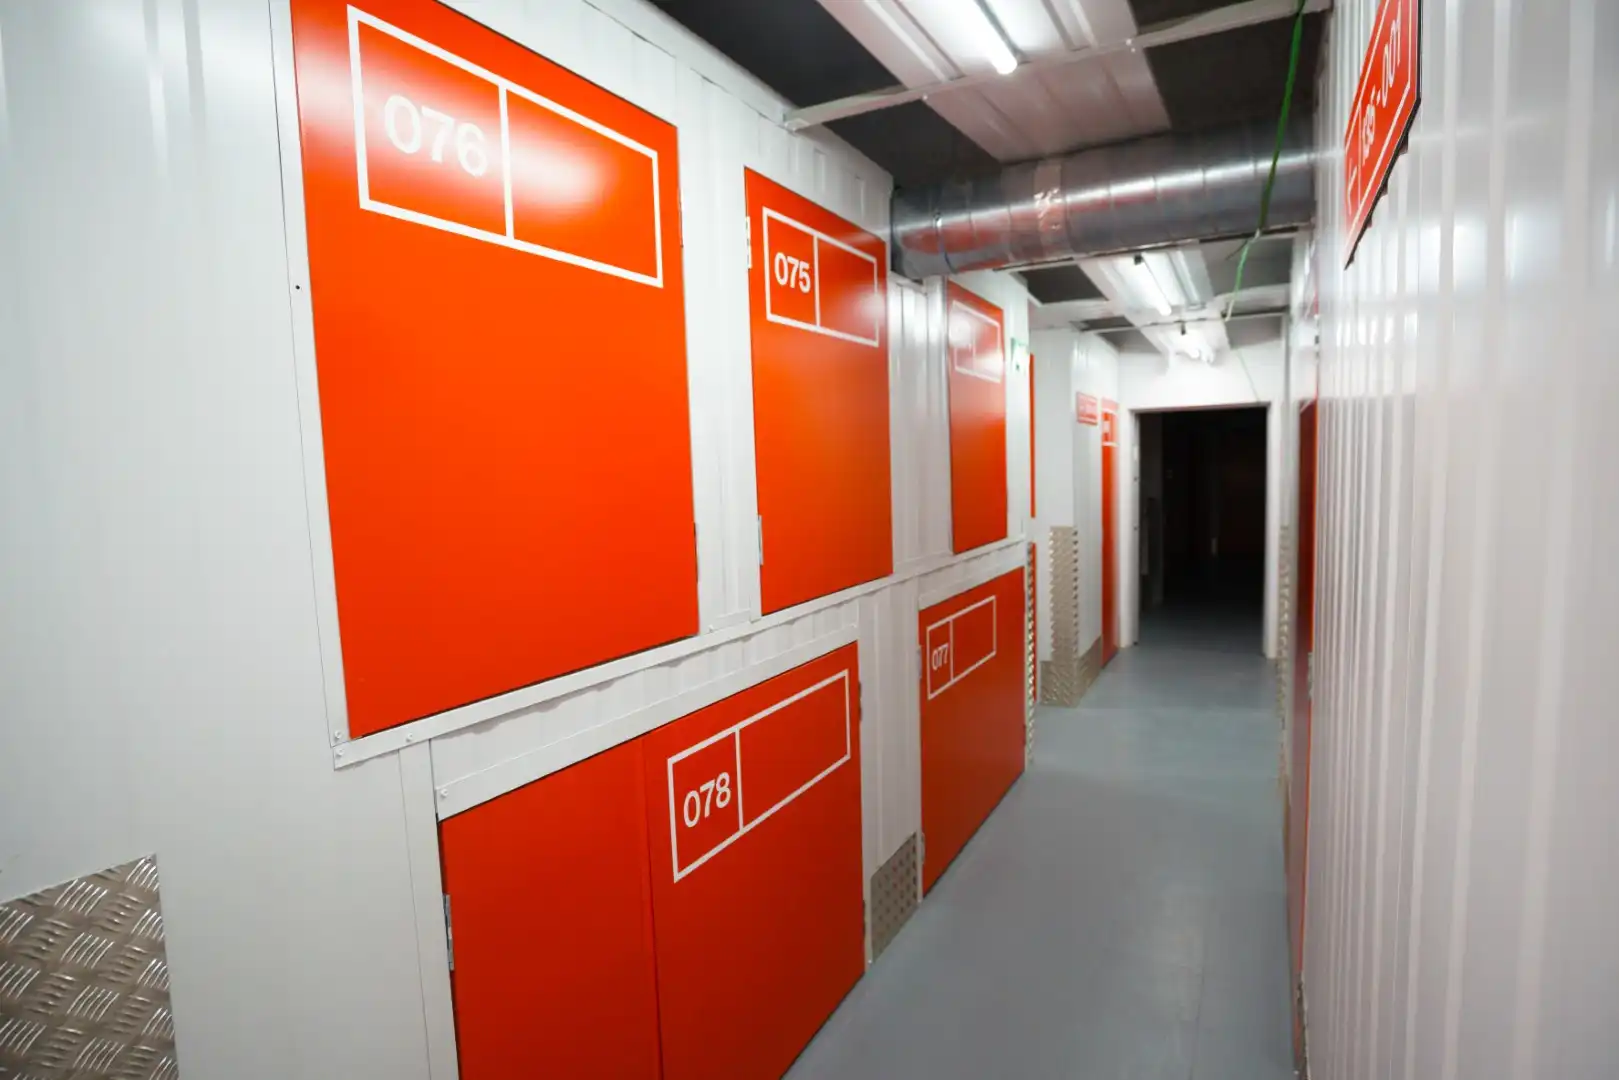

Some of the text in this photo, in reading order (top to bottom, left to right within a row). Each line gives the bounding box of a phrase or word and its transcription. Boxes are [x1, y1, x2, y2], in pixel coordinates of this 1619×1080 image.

[384, 94, 489, 178] 076
[774, 251, 812, 294] 075
[932, 642, 950, 671] 077
[683, 771, 732, 828] 078
